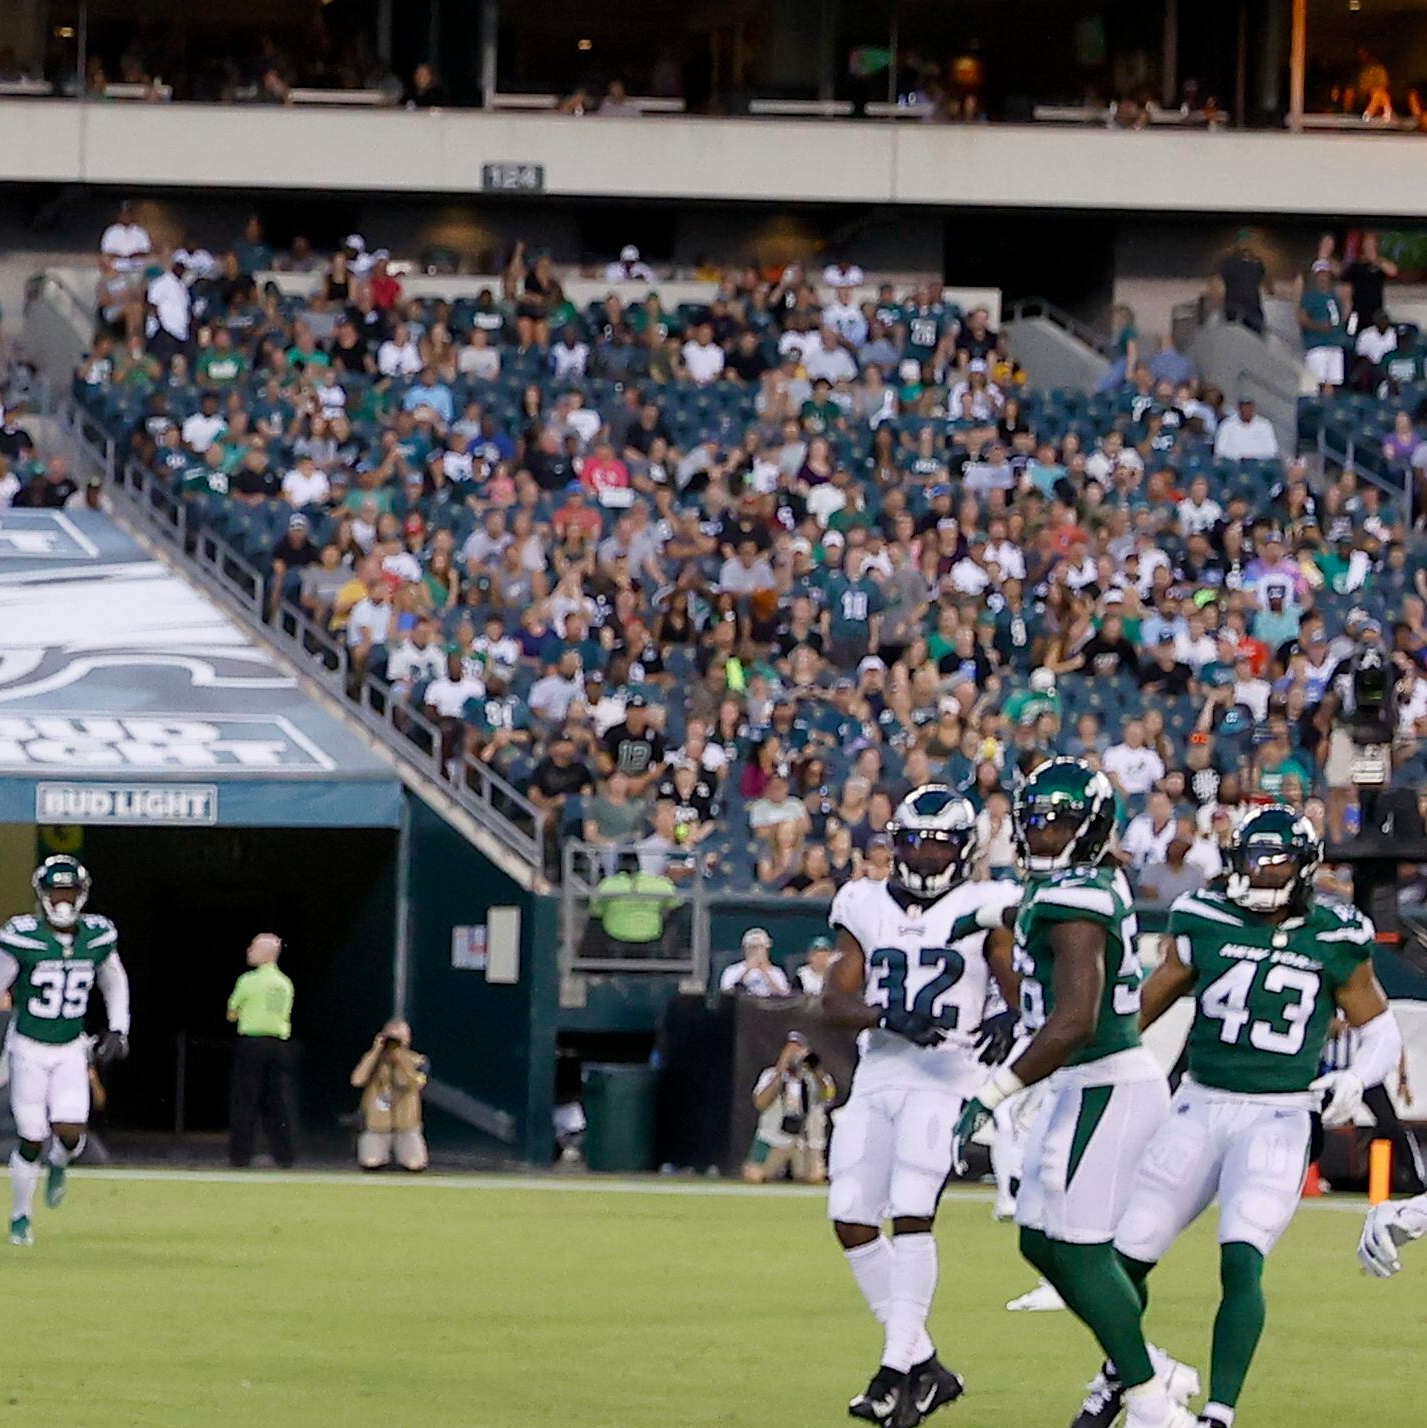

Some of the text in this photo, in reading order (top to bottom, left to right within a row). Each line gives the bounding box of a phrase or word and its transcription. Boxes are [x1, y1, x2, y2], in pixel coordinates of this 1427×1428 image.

[45, 789, 210, 816] BUD LIGHT
[869, 948, 966, 1030] 32
[1200, 959, 1321, 1056] 43
